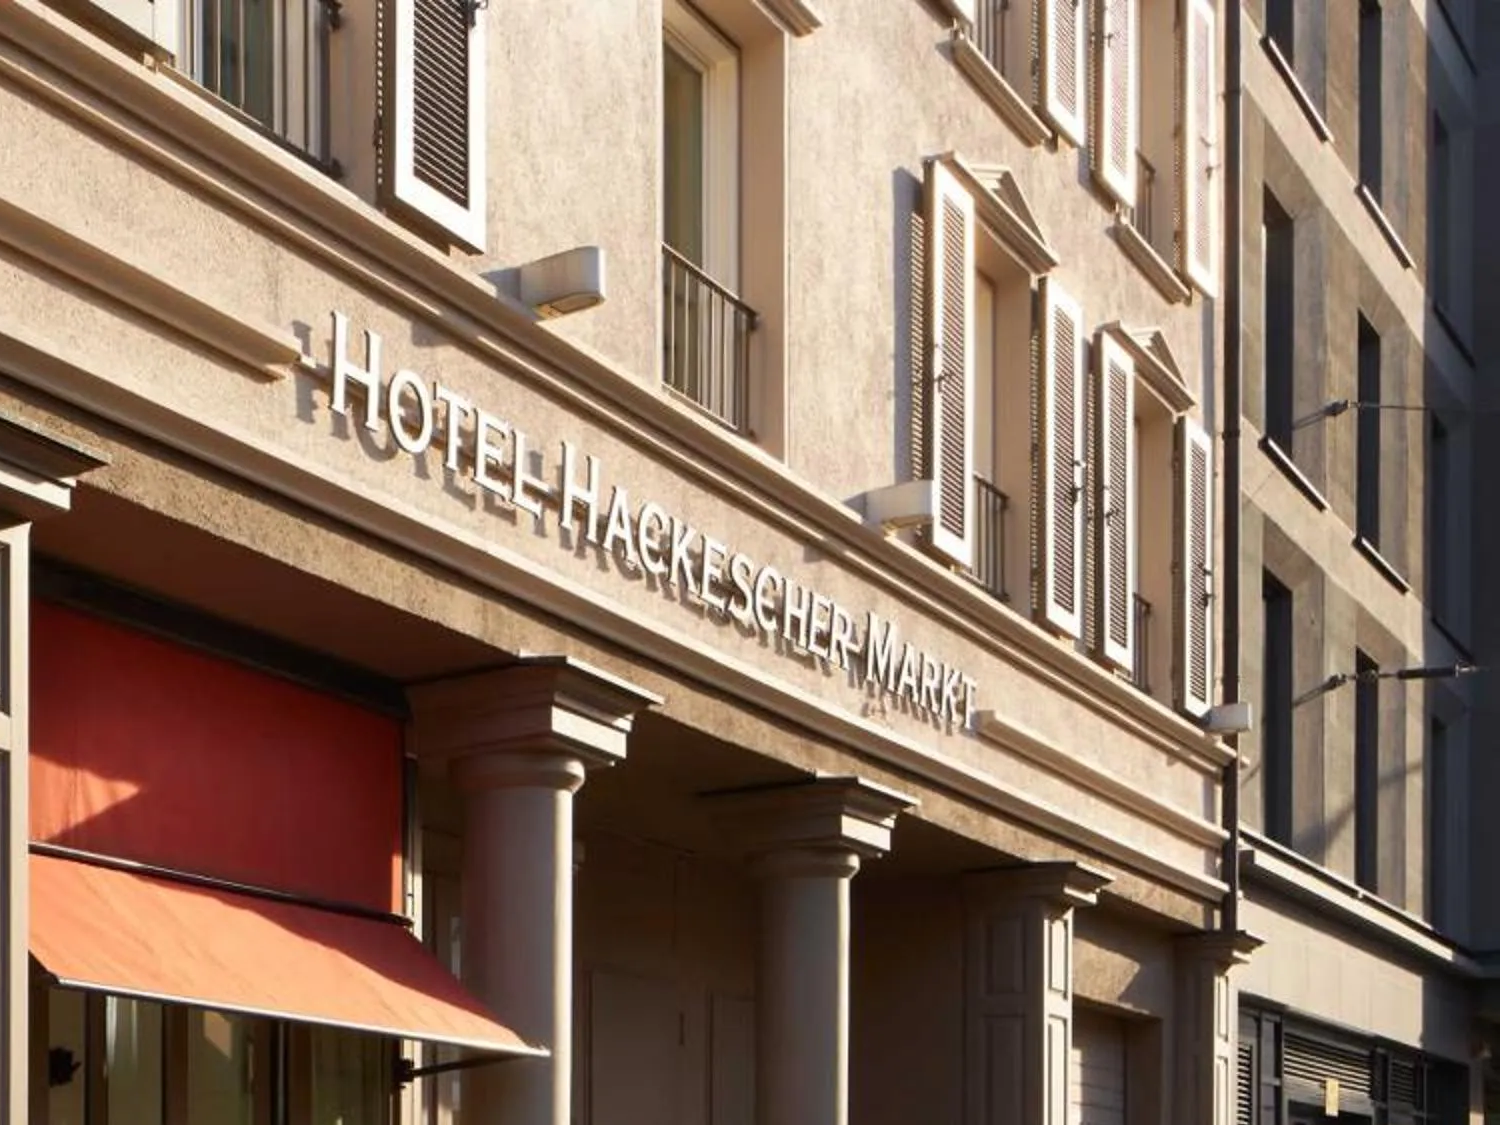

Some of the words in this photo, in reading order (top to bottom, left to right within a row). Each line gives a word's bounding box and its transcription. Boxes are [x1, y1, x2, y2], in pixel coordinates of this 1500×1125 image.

[328, 310, 543, 520] HOTEL
[559, 441, 852, 672] HACKESCHER
[866, 611, 978, 731] MARKT
